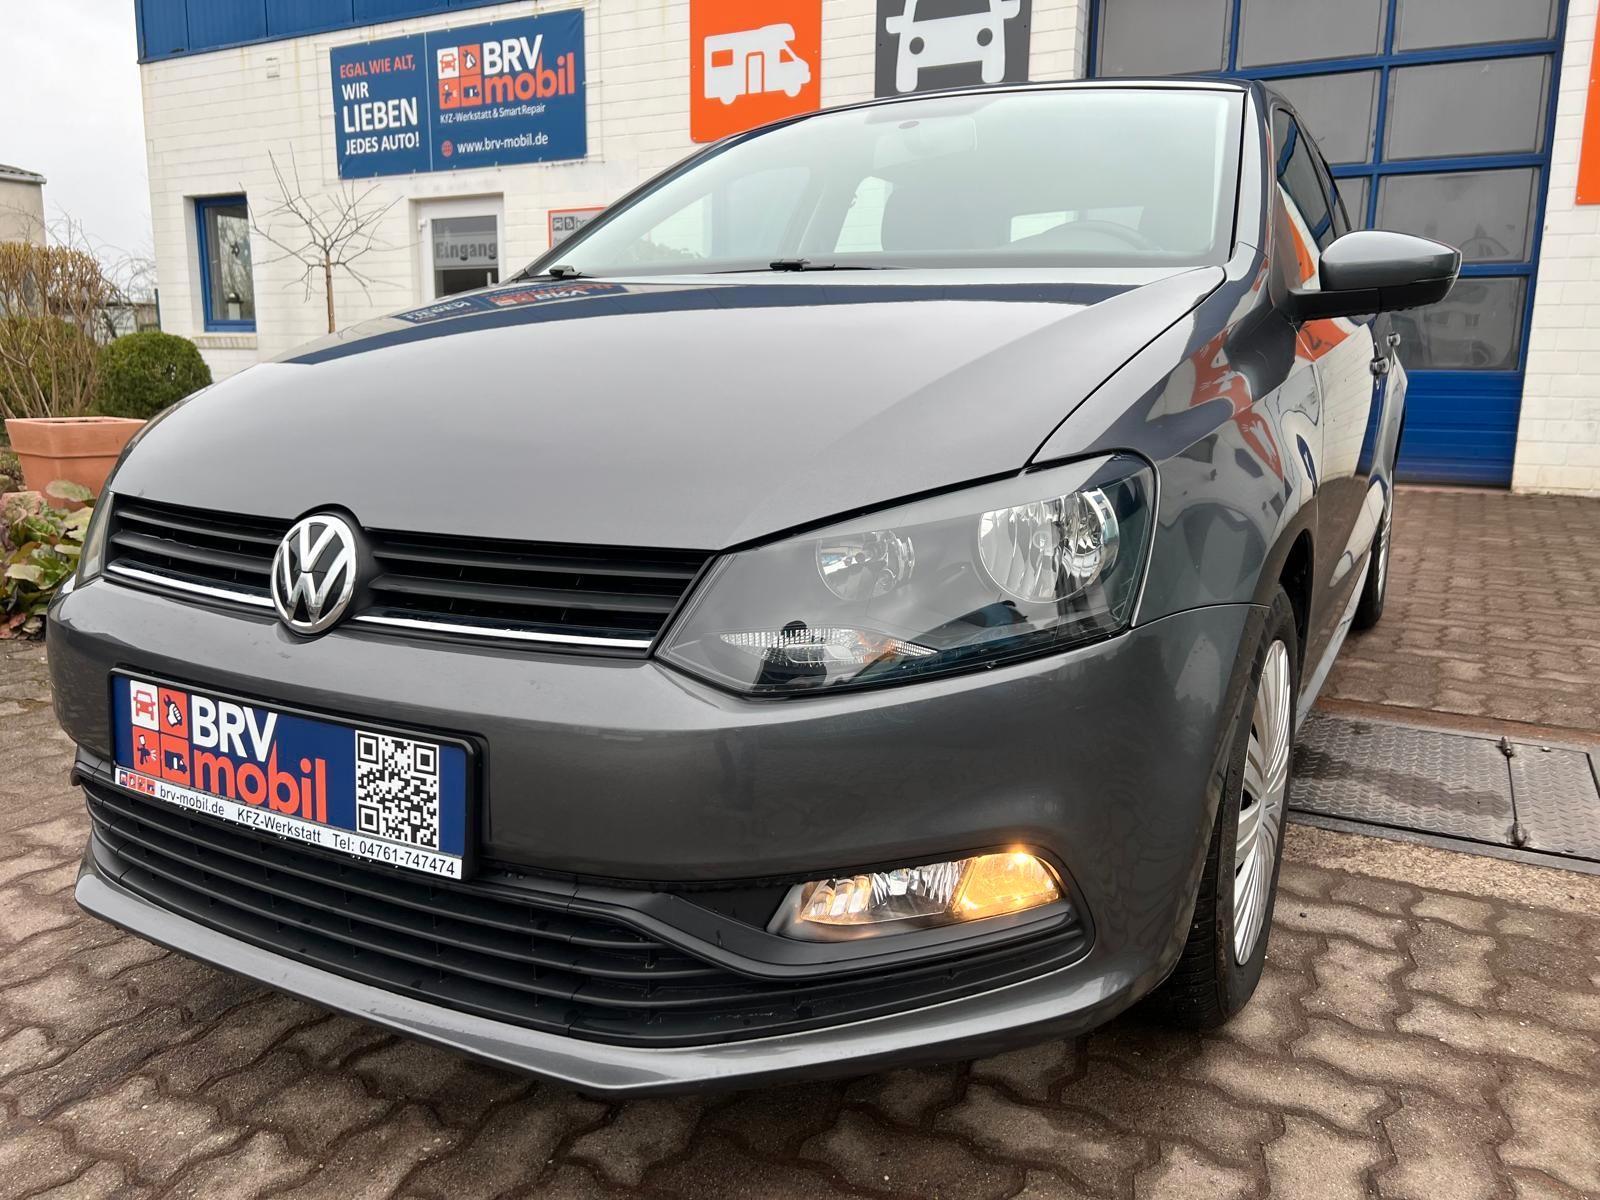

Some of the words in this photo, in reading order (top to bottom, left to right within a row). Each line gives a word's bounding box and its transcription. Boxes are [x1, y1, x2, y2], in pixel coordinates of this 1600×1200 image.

[340, 62, 367, 79] EGAL
[369, 59, 392, 75] WIE
[393, 54, 416, 72] ALT,
[483, 34, 544, 75] BRV
[342, 81, 369, 101] WIR
[485, 52, 575, 104] mobil
[343, 97, 418, 133] LIEBEN
[492, 108, 498, 117] &
[499, 105, 522, 117] Smart
[522, 103, 546, 116] Repair
[345, 138, 379, 156] JEDES
[381, 131, 420, 152] AUTO!
[457, 131, 548, 154] www.brv-mobil.de
[436, 242, 496, 261] Eingang
[191, 694, 277, 763] BRV
[194, 741, 328, 824] mobil
[160, 784, 225, 816] brv-mobil.de
[237, 807, 322, 844] KFZ-Werkstatt
[333, 833, 355, 851] Tel:
[359, 839, 456, 876] 04761-747474
